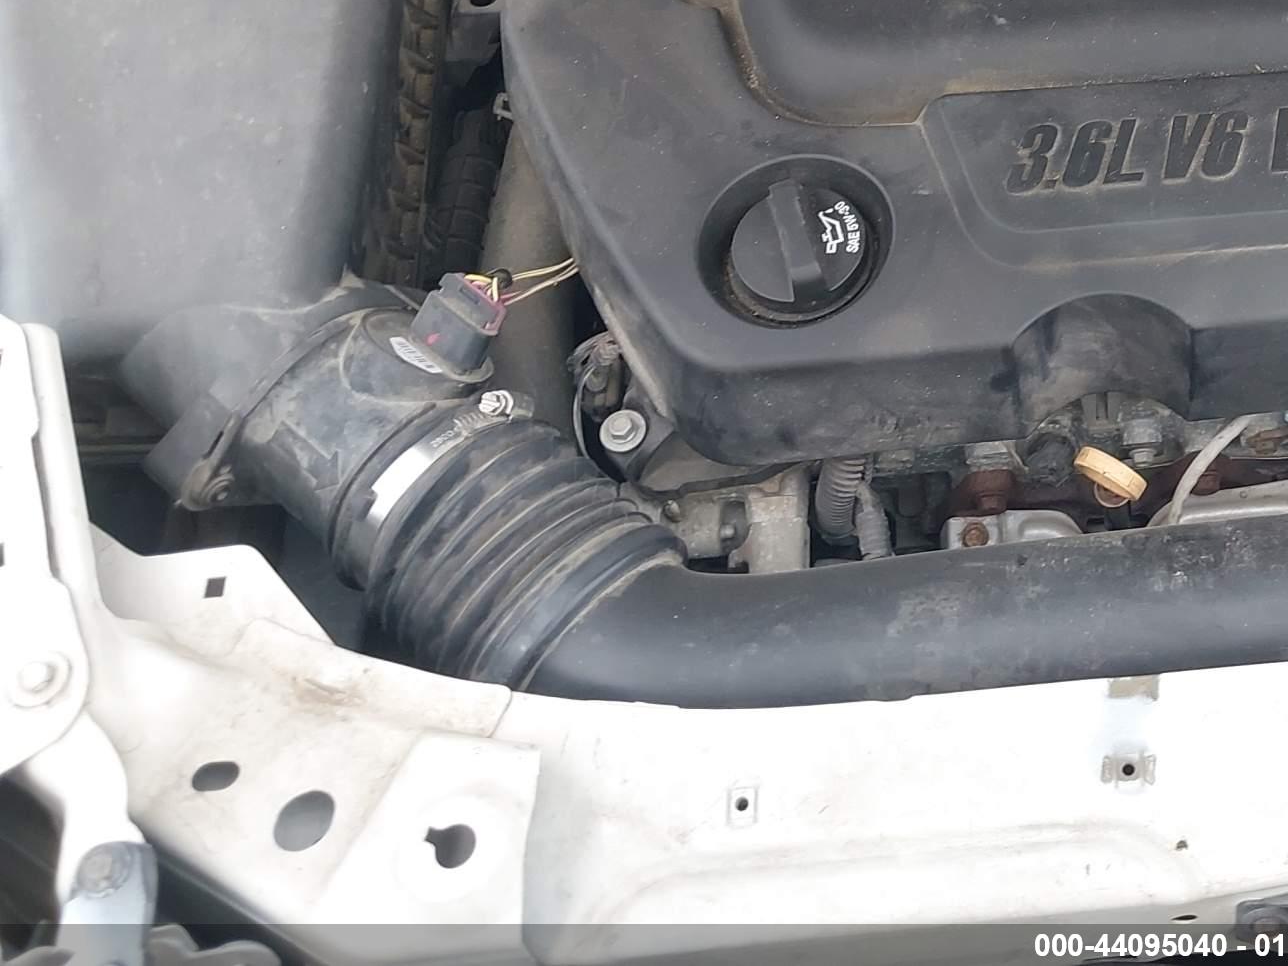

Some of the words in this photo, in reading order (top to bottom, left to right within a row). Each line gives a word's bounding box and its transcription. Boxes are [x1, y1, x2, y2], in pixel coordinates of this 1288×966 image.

[1006, 116, 1145, 195] 3.6L
[1163, 111, 1251, 183] V6
[834, 201, 859, 232] 5W-30
[845, 230, 861, 253] SAE
